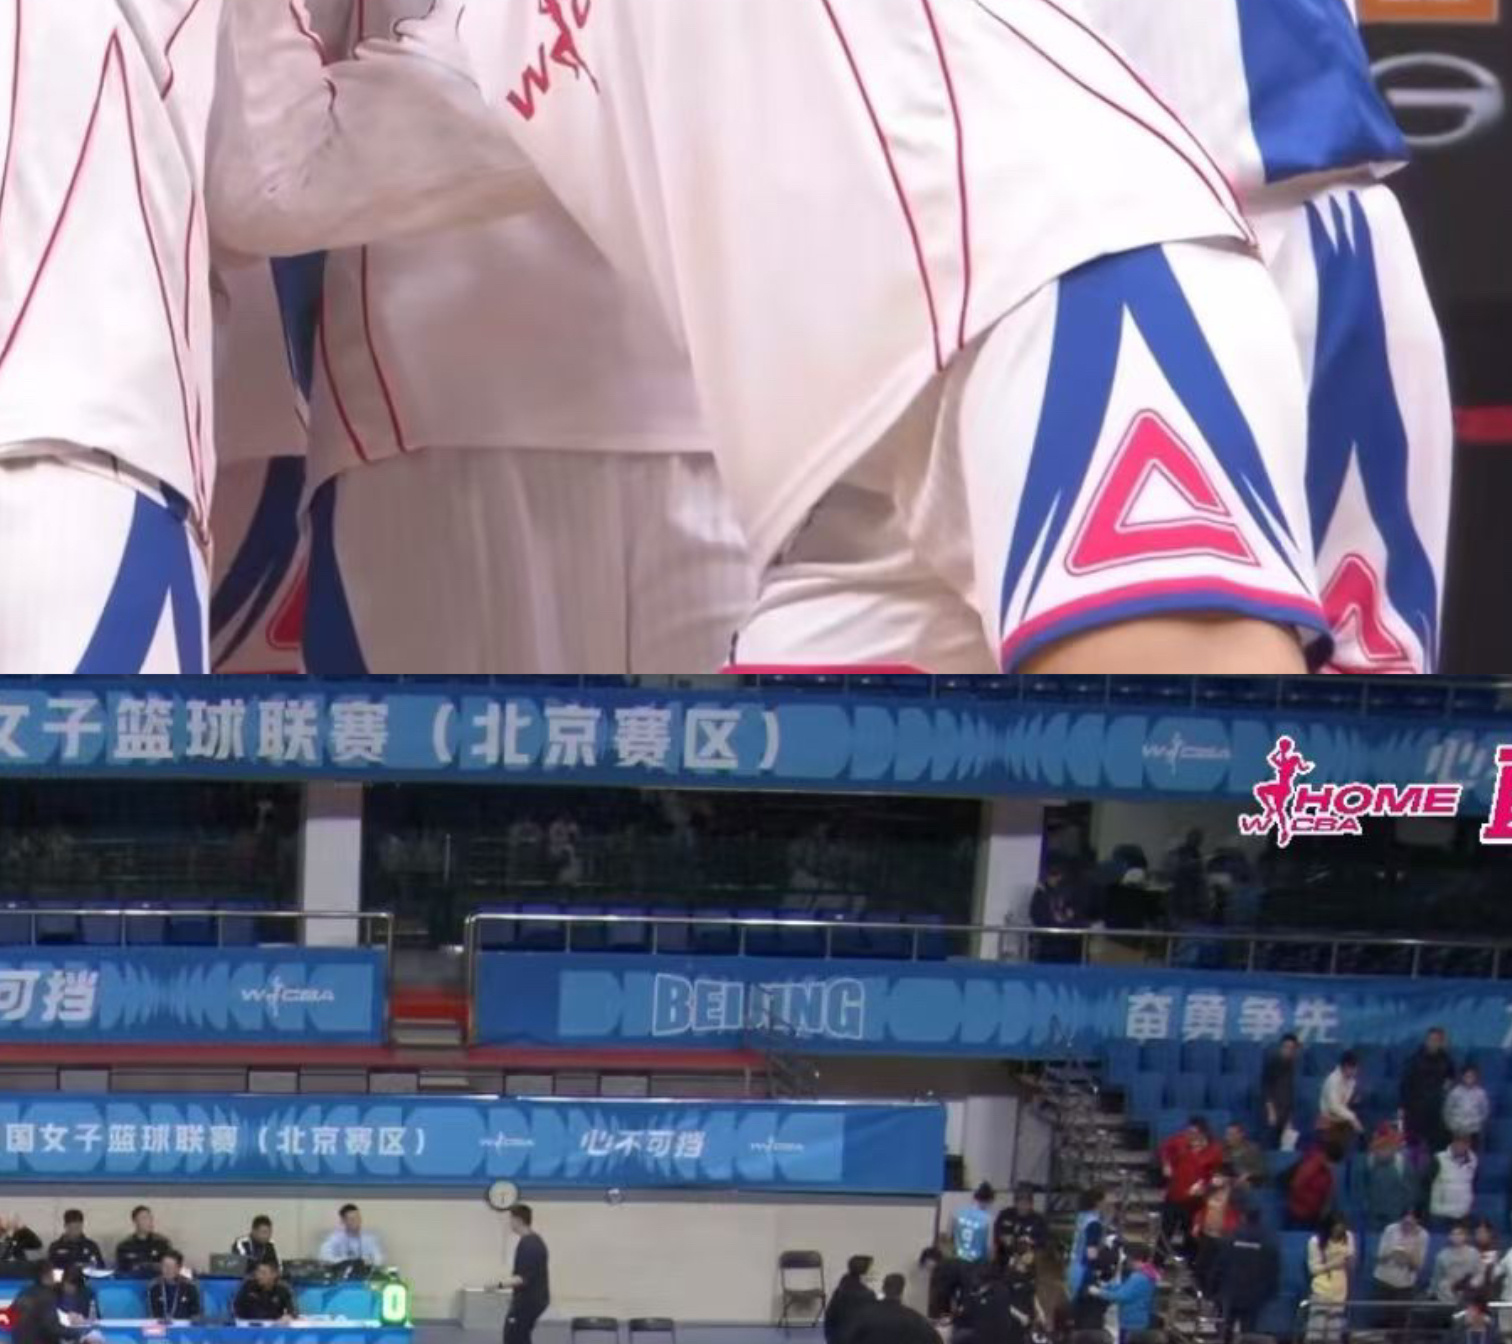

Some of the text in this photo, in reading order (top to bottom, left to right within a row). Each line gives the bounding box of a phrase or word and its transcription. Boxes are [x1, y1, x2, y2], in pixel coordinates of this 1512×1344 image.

[652, 972, 866, 1040] BEIJING
[1125, 992, 1339, 1044] 奋勇争先
[579, 1129, 706, 1158] 心不可挡
